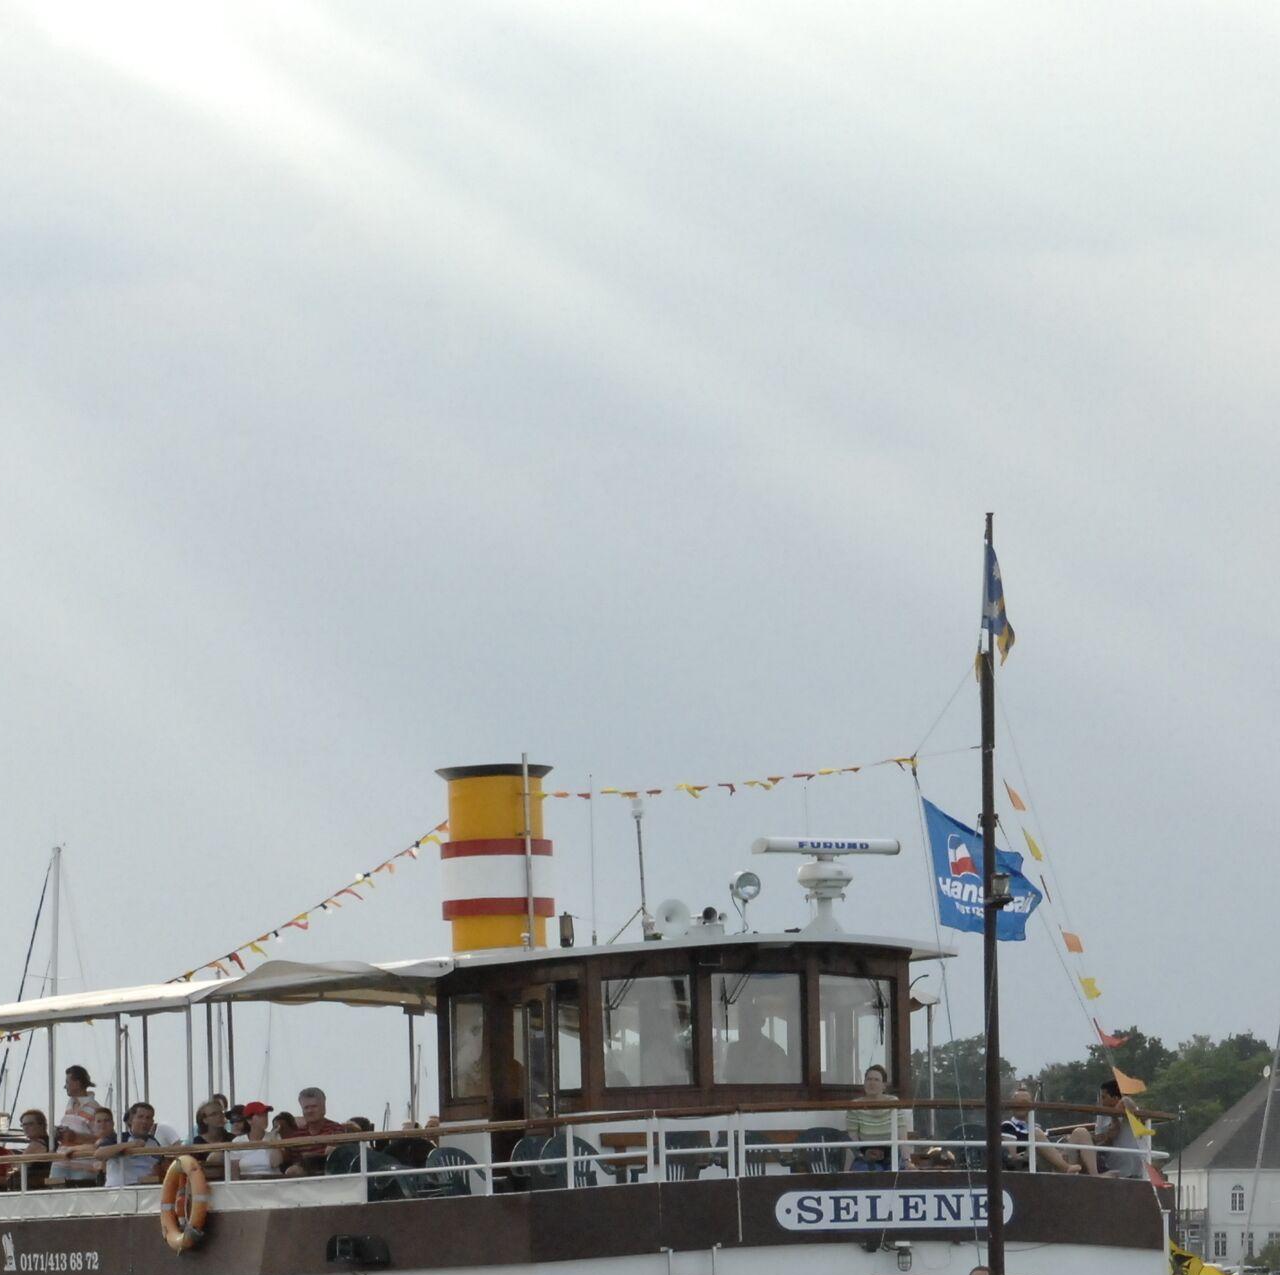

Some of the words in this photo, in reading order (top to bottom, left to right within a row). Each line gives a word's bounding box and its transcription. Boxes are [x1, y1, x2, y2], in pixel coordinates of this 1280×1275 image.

[798, 841, 870, 850] FURUNO
[21, 1252, 67, 1272] 0171/413
[70, 1252, 83, 1270] 68
[86, 1251, 99, 1270] 72
